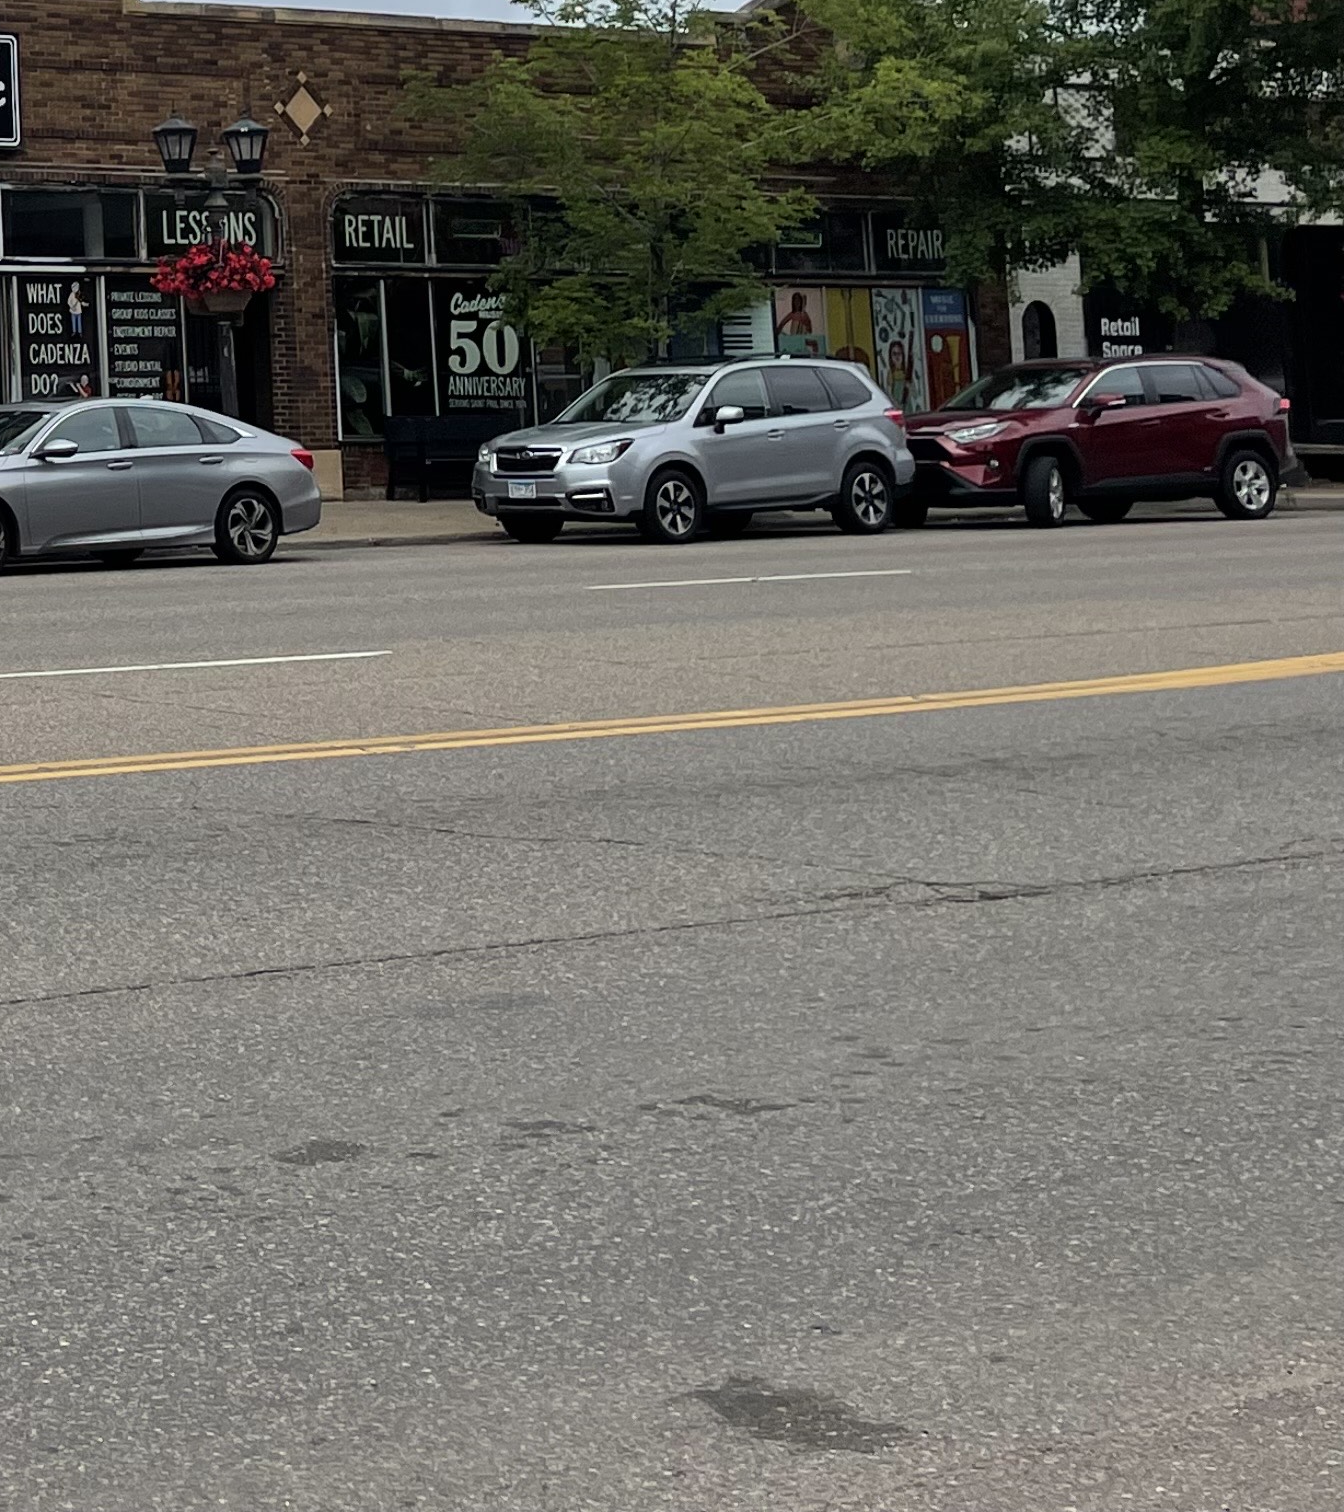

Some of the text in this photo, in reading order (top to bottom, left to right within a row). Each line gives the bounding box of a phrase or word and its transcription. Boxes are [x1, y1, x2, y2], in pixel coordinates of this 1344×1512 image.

[344, 215, 414, 248] RETAIL
[887, 229, 944, 259] REPAIR
[26, 283, 62, 304] WHAT
[28, 313, 63, 334] DOES
[1101, 316, 1140, 336] Retail
[29, 343, 91, 365] CADENZA
[114, 344, 138, 355] EVENTS
[448, 320, 519, 375] 50
[115, 361, 162, 372] STUDIO RENTAL
[31, 374, 59, 395] DO?
[448, 376, 526, 397] ANNIVERSARY
